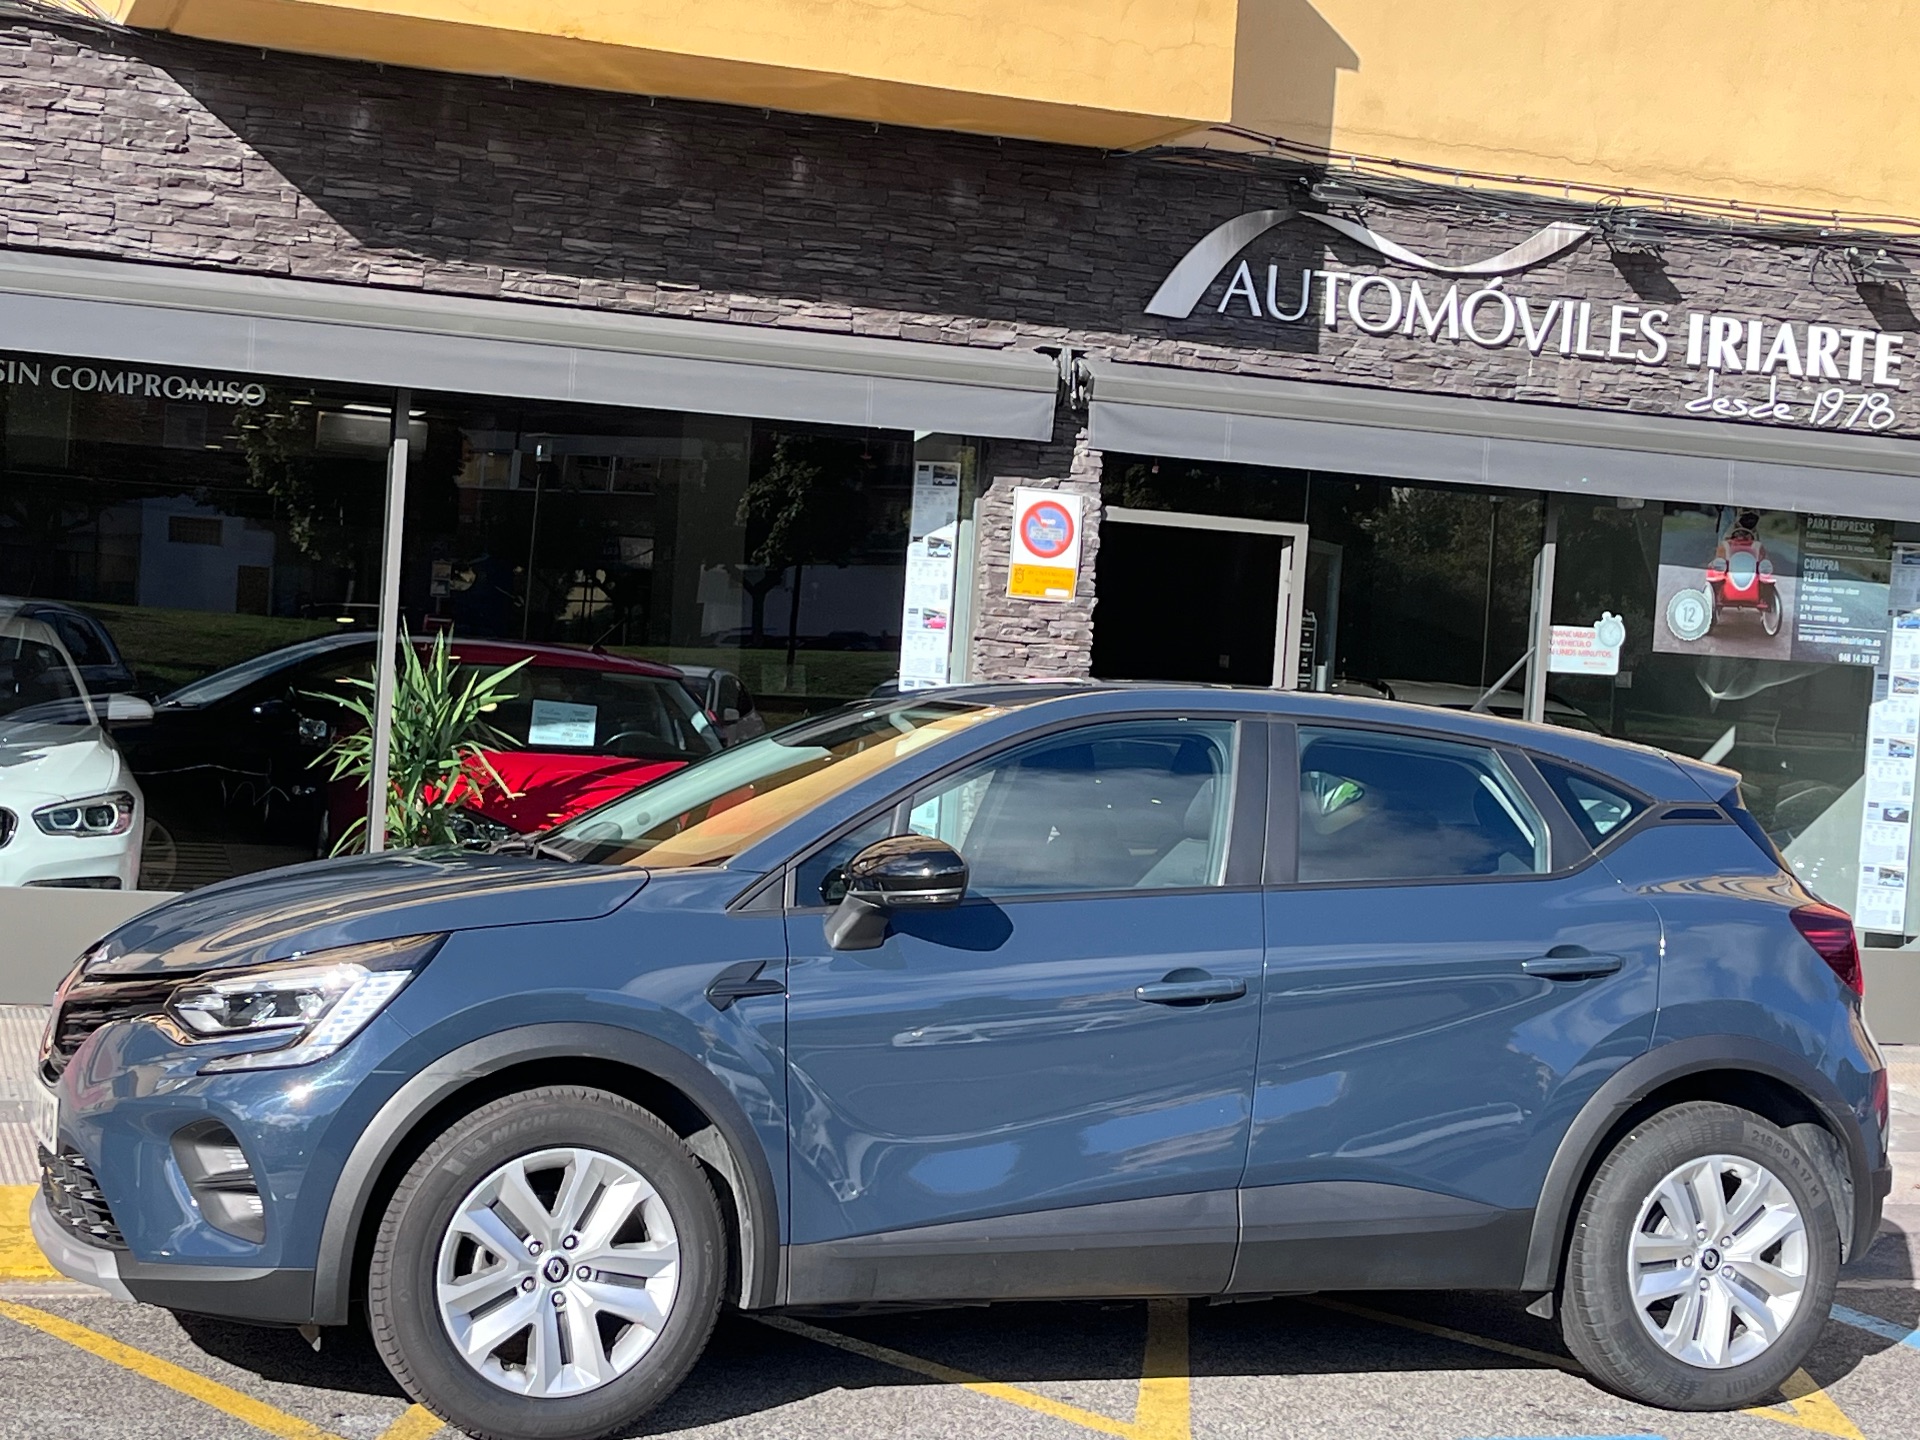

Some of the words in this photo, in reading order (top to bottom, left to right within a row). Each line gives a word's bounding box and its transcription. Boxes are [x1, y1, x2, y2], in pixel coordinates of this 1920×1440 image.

[1217, 259, 1668, 365] AUTOMÓVILES
[1686, 313, 1903, 386] IRIARTE
[51, 365, 266, 407] COMPROMISO
[1685, 368, 1794, 421] desde
[1807, 387, 1896, 430] 1978
[1807, 517, 1829, 530] PARA
[1830, 519, 1875, 534] EMPRESAS
[1803, 558, 1840, 571] COMPRA
[1802, 571, 1829, 584] VENTA
[1683, 606, 1695, 623] 12
